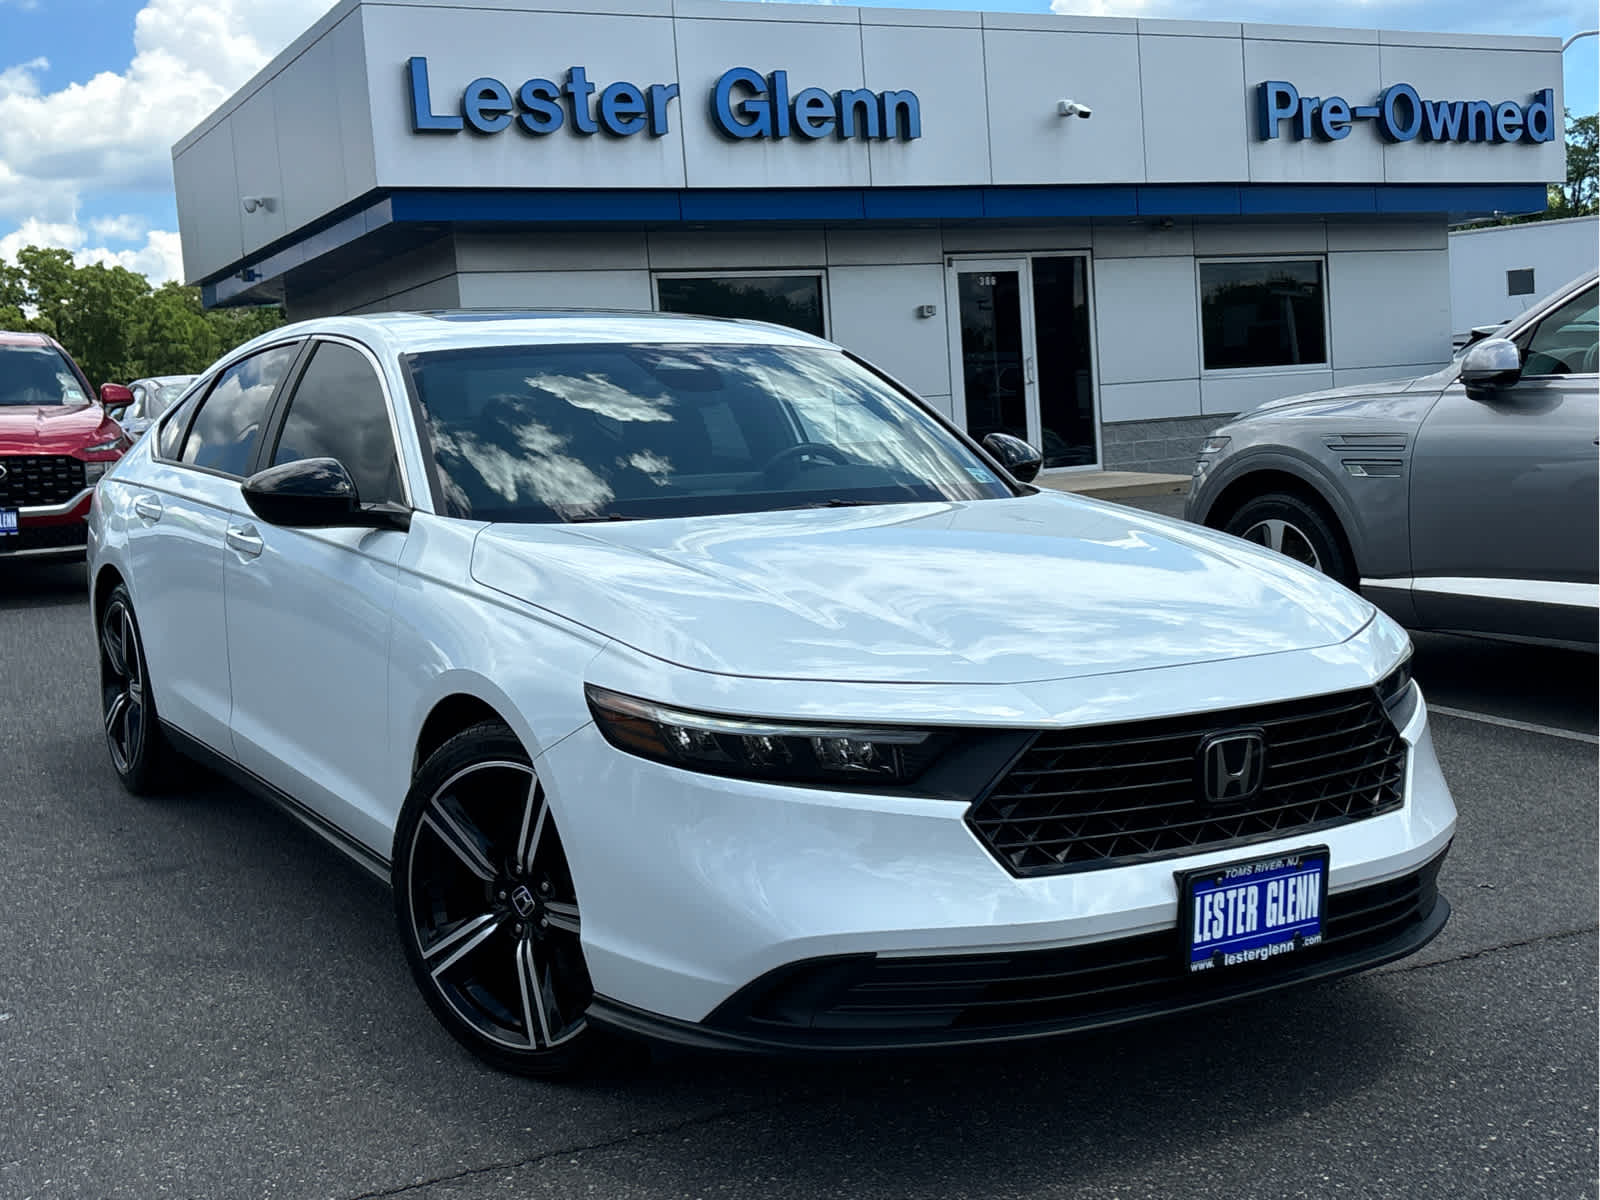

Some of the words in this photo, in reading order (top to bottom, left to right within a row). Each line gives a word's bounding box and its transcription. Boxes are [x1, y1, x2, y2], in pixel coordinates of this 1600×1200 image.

[406, 56, 680, 137] Lester
[711, 67, 922, 140] Glenn
[1256, 80, 1555, 144] Pre-Owned
[1225, 866, 1253, 879] TOMS
[1193, 885, 1259, 944] LESTER
[1265, 872, 1321, 928] GLENN
[1190, 959, 1215, 973] www.
[1224, 941, 1295, 966] lesterglenn
